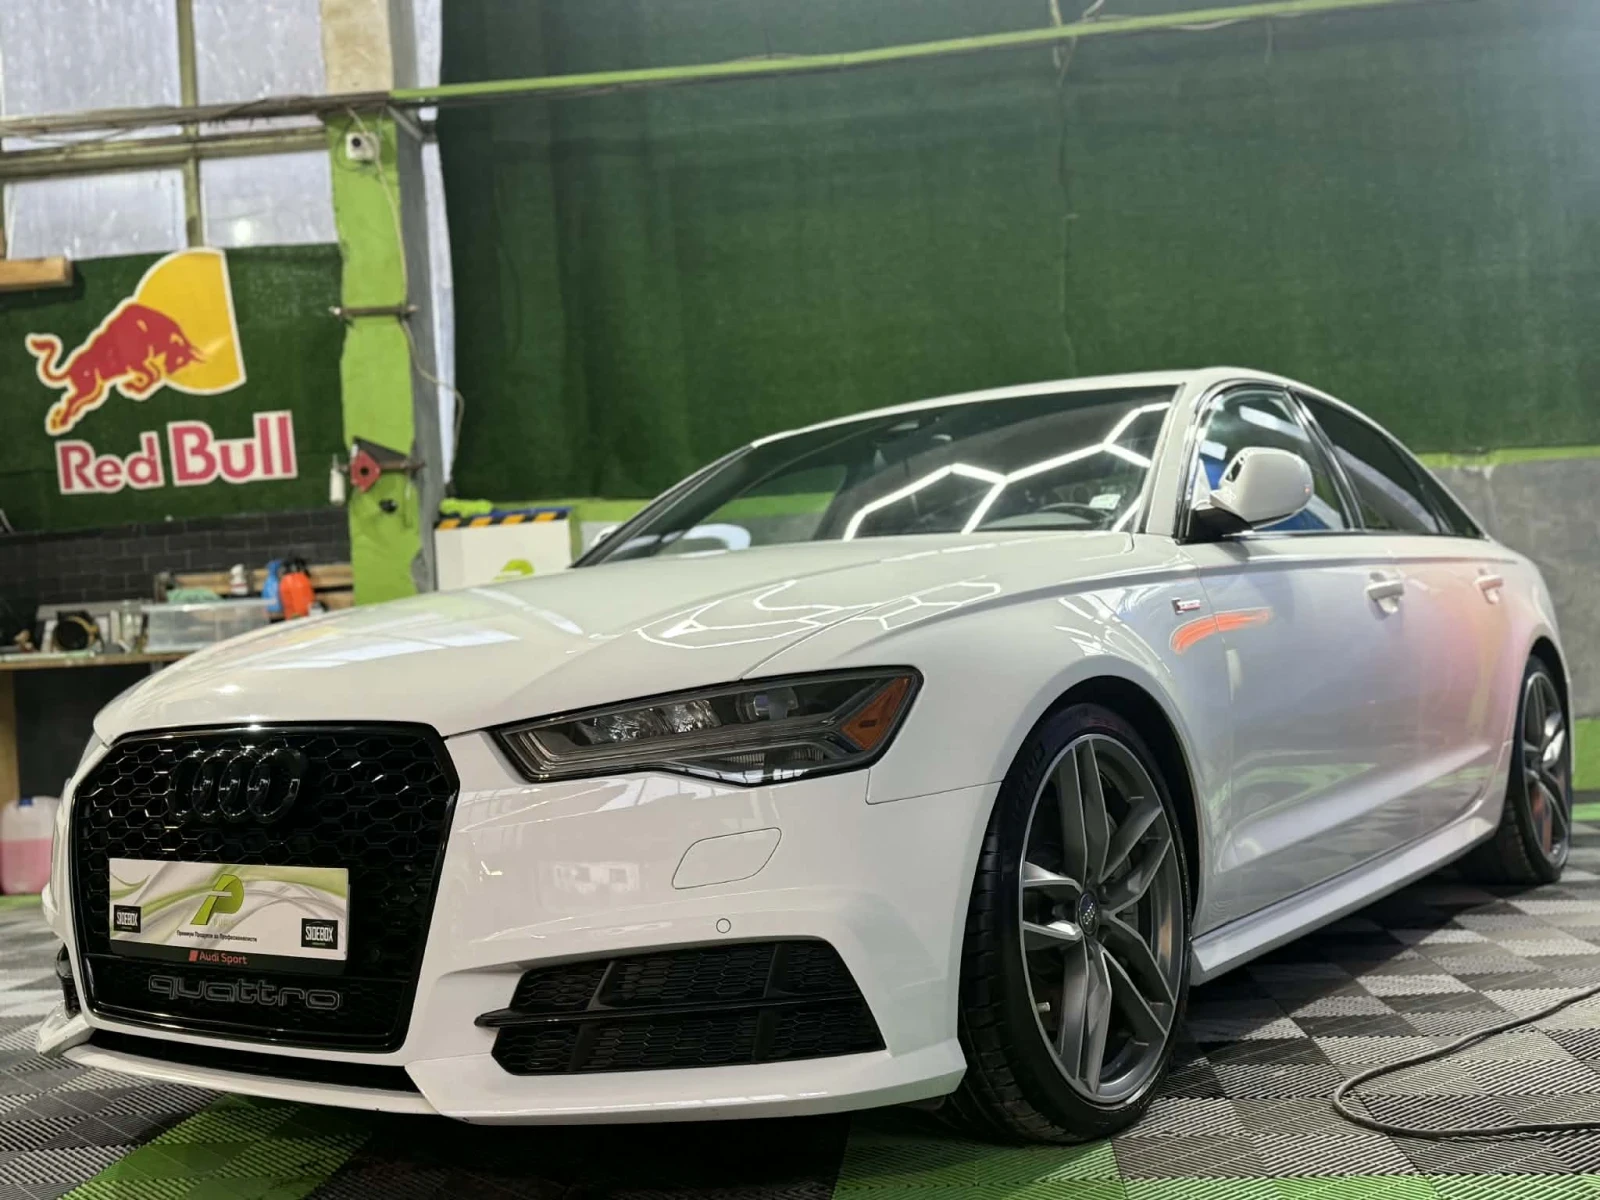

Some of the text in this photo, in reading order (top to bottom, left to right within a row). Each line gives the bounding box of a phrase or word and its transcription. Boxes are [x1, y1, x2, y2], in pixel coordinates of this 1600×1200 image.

[58, 414, 295, 492] Red Bull
[116, 911, 138, 927] SIDEBOX
[305, 925, 334, 943] SIDEBOX
[199, 951, 248, 965] Audi Sport
[147, 974, 341, 1011] quattro
